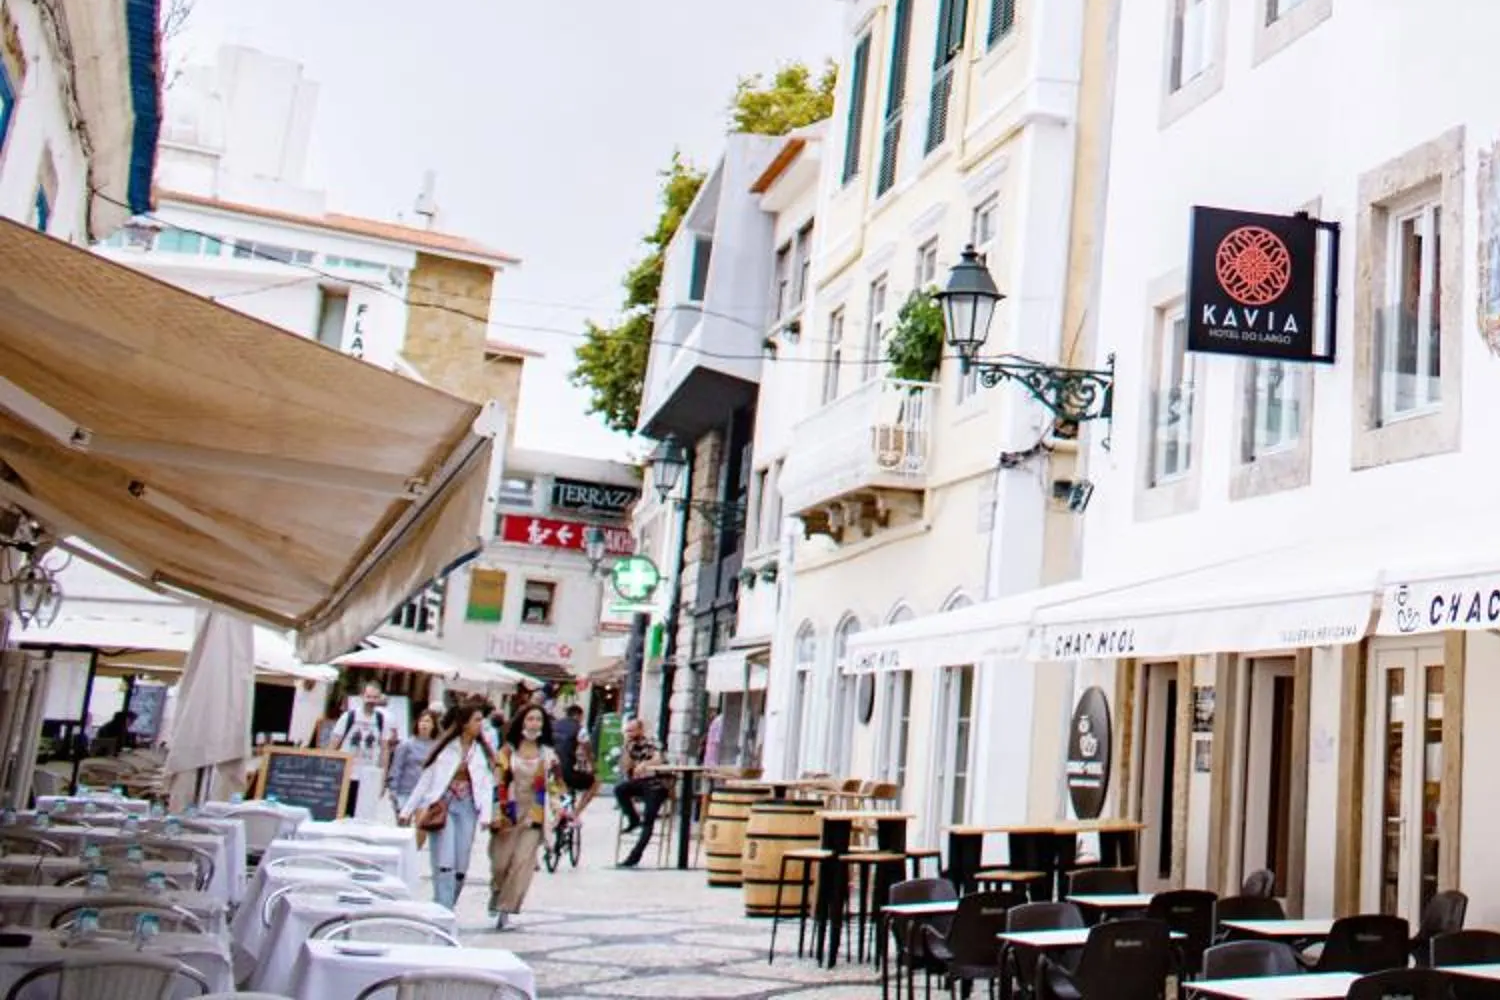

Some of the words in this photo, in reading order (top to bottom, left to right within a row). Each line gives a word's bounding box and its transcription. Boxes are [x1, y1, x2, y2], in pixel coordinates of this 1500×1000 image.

[351, 303, 368, 358] FLA
[1202, 303, 1299, 333] KAVIA
[1209, 328, 1238, 339] HOTEL
[1241, 331, 1257, 341] DO
[1258, 332, 1291, 345] LARGO
